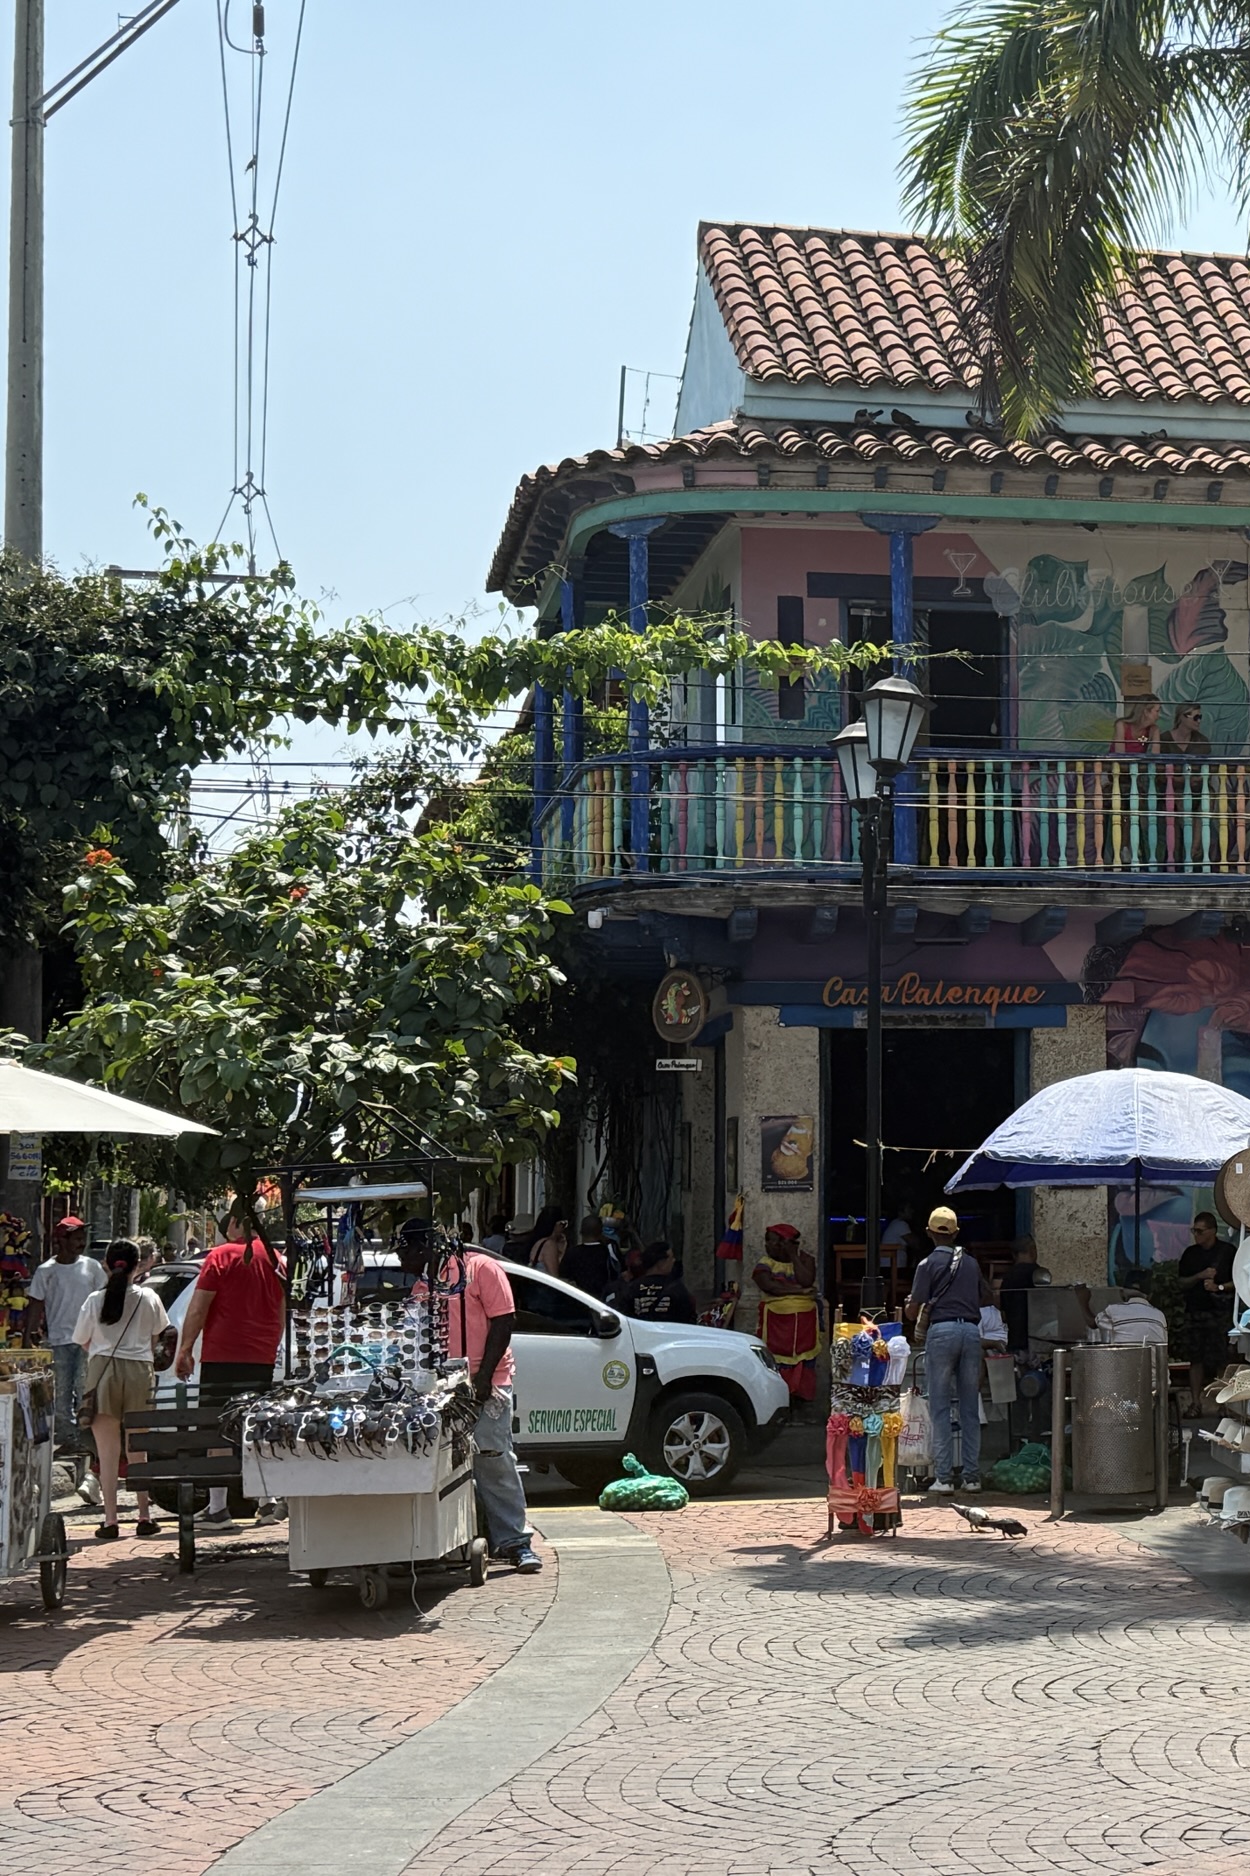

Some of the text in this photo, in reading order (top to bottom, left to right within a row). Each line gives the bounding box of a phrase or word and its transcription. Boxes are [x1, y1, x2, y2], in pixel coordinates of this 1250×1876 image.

[896, 972, 1046, 1017] Palenque
[528, 1408, 618, 1434] SERVICIO ESPECIAL
